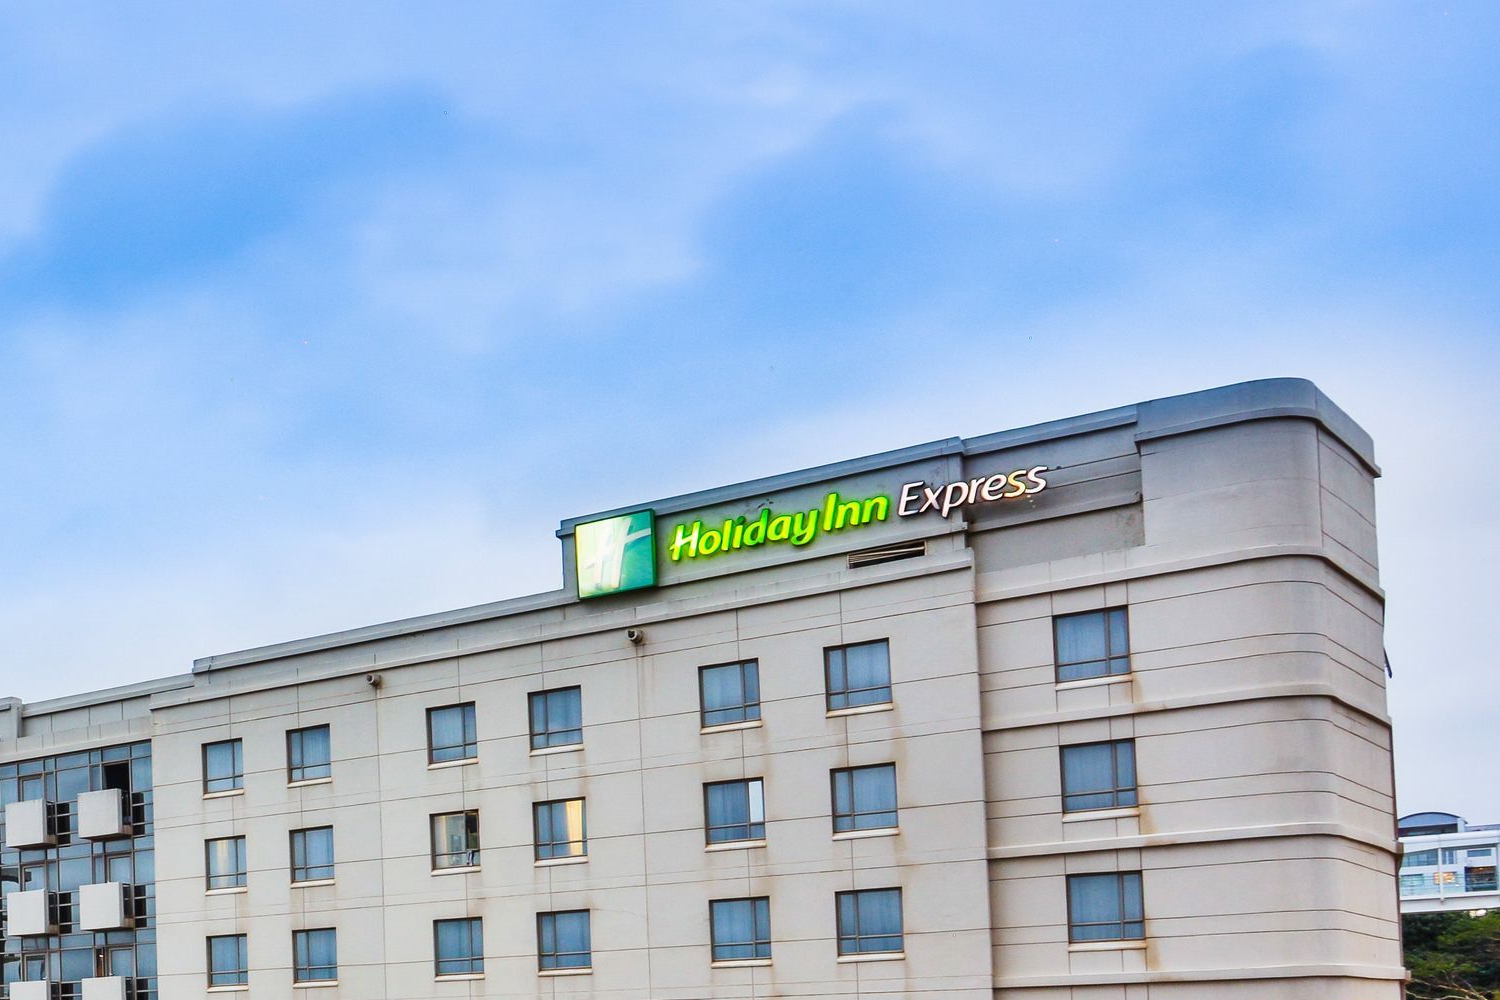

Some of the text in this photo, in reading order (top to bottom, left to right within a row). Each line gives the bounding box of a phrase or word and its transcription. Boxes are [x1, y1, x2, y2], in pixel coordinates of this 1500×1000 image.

[669, 464, 1049, 561] Holiday Inn Express
